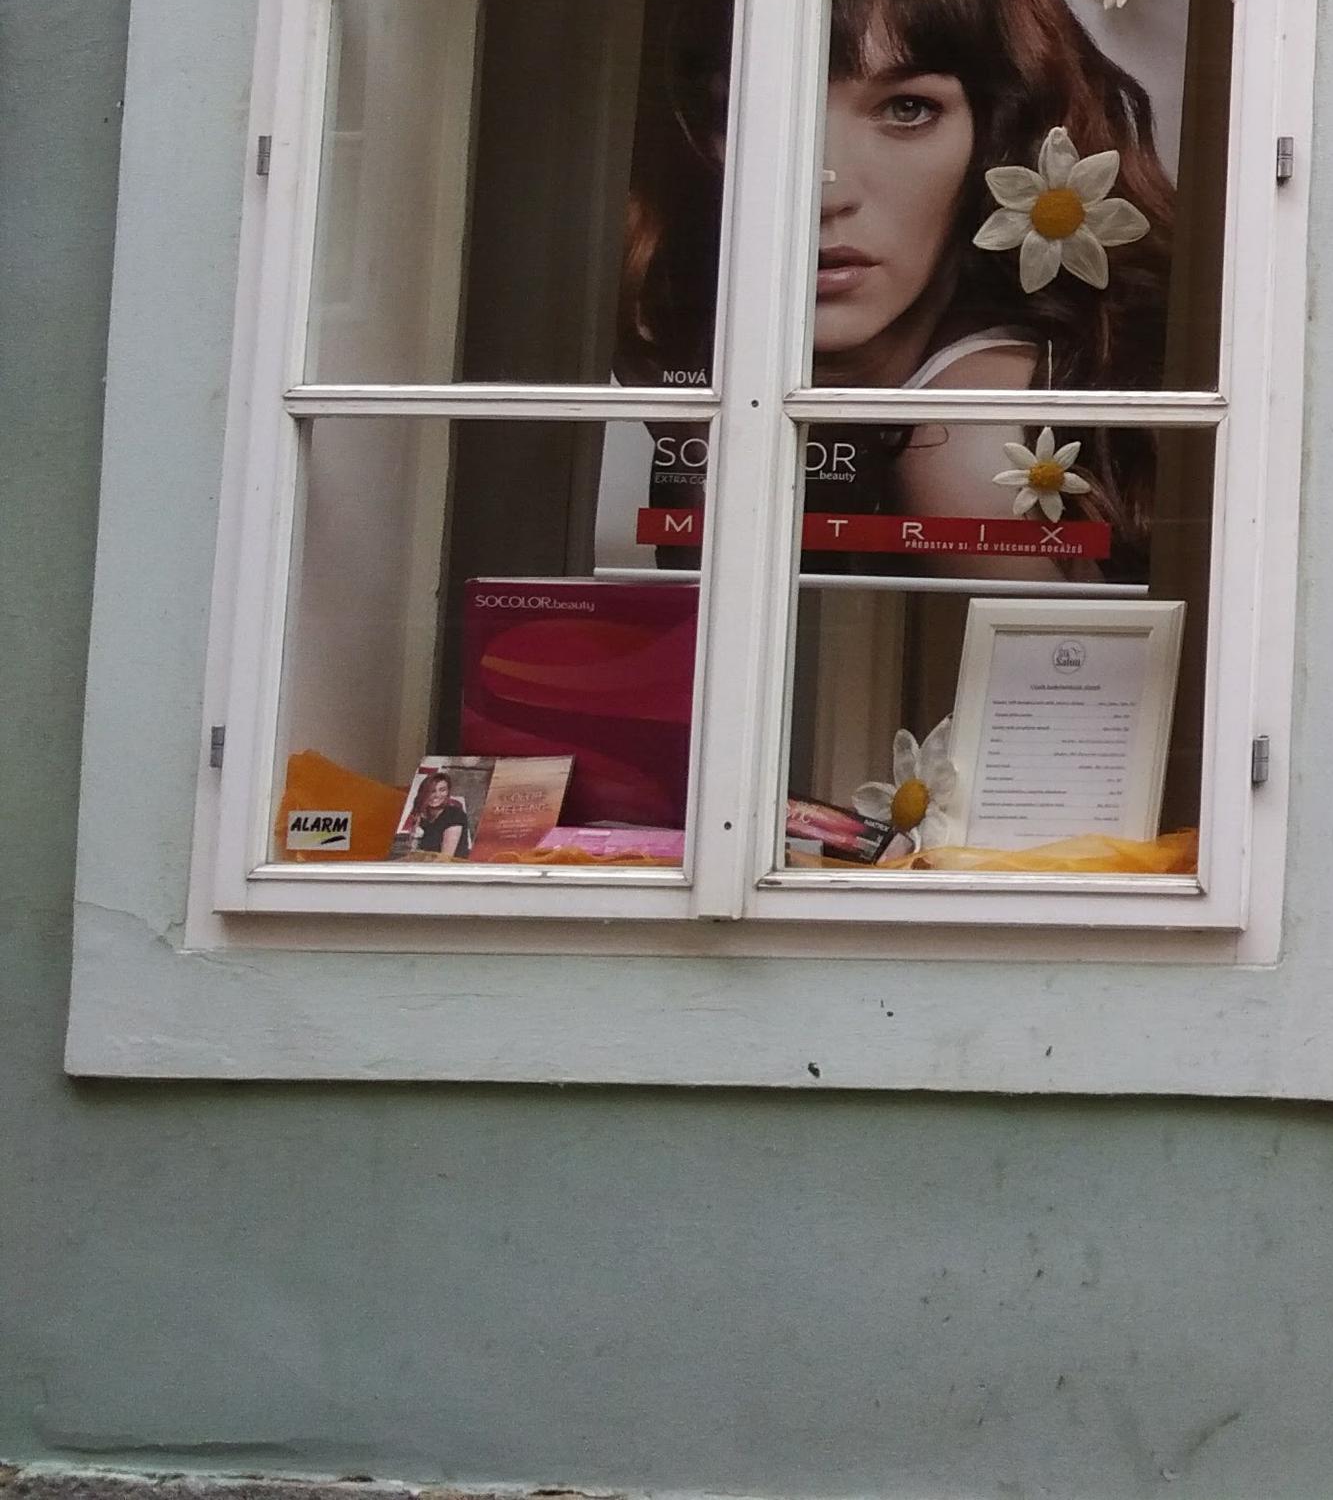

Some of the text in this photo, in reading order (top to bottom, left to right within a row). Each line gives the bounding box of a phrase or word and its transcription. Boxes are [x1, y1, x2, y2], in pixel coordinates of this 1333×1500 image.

[662, 367, 707, 384] NOVÁ
[819, 470, 857, 483] beauty
[290, 816, 349, 832] ALARM
